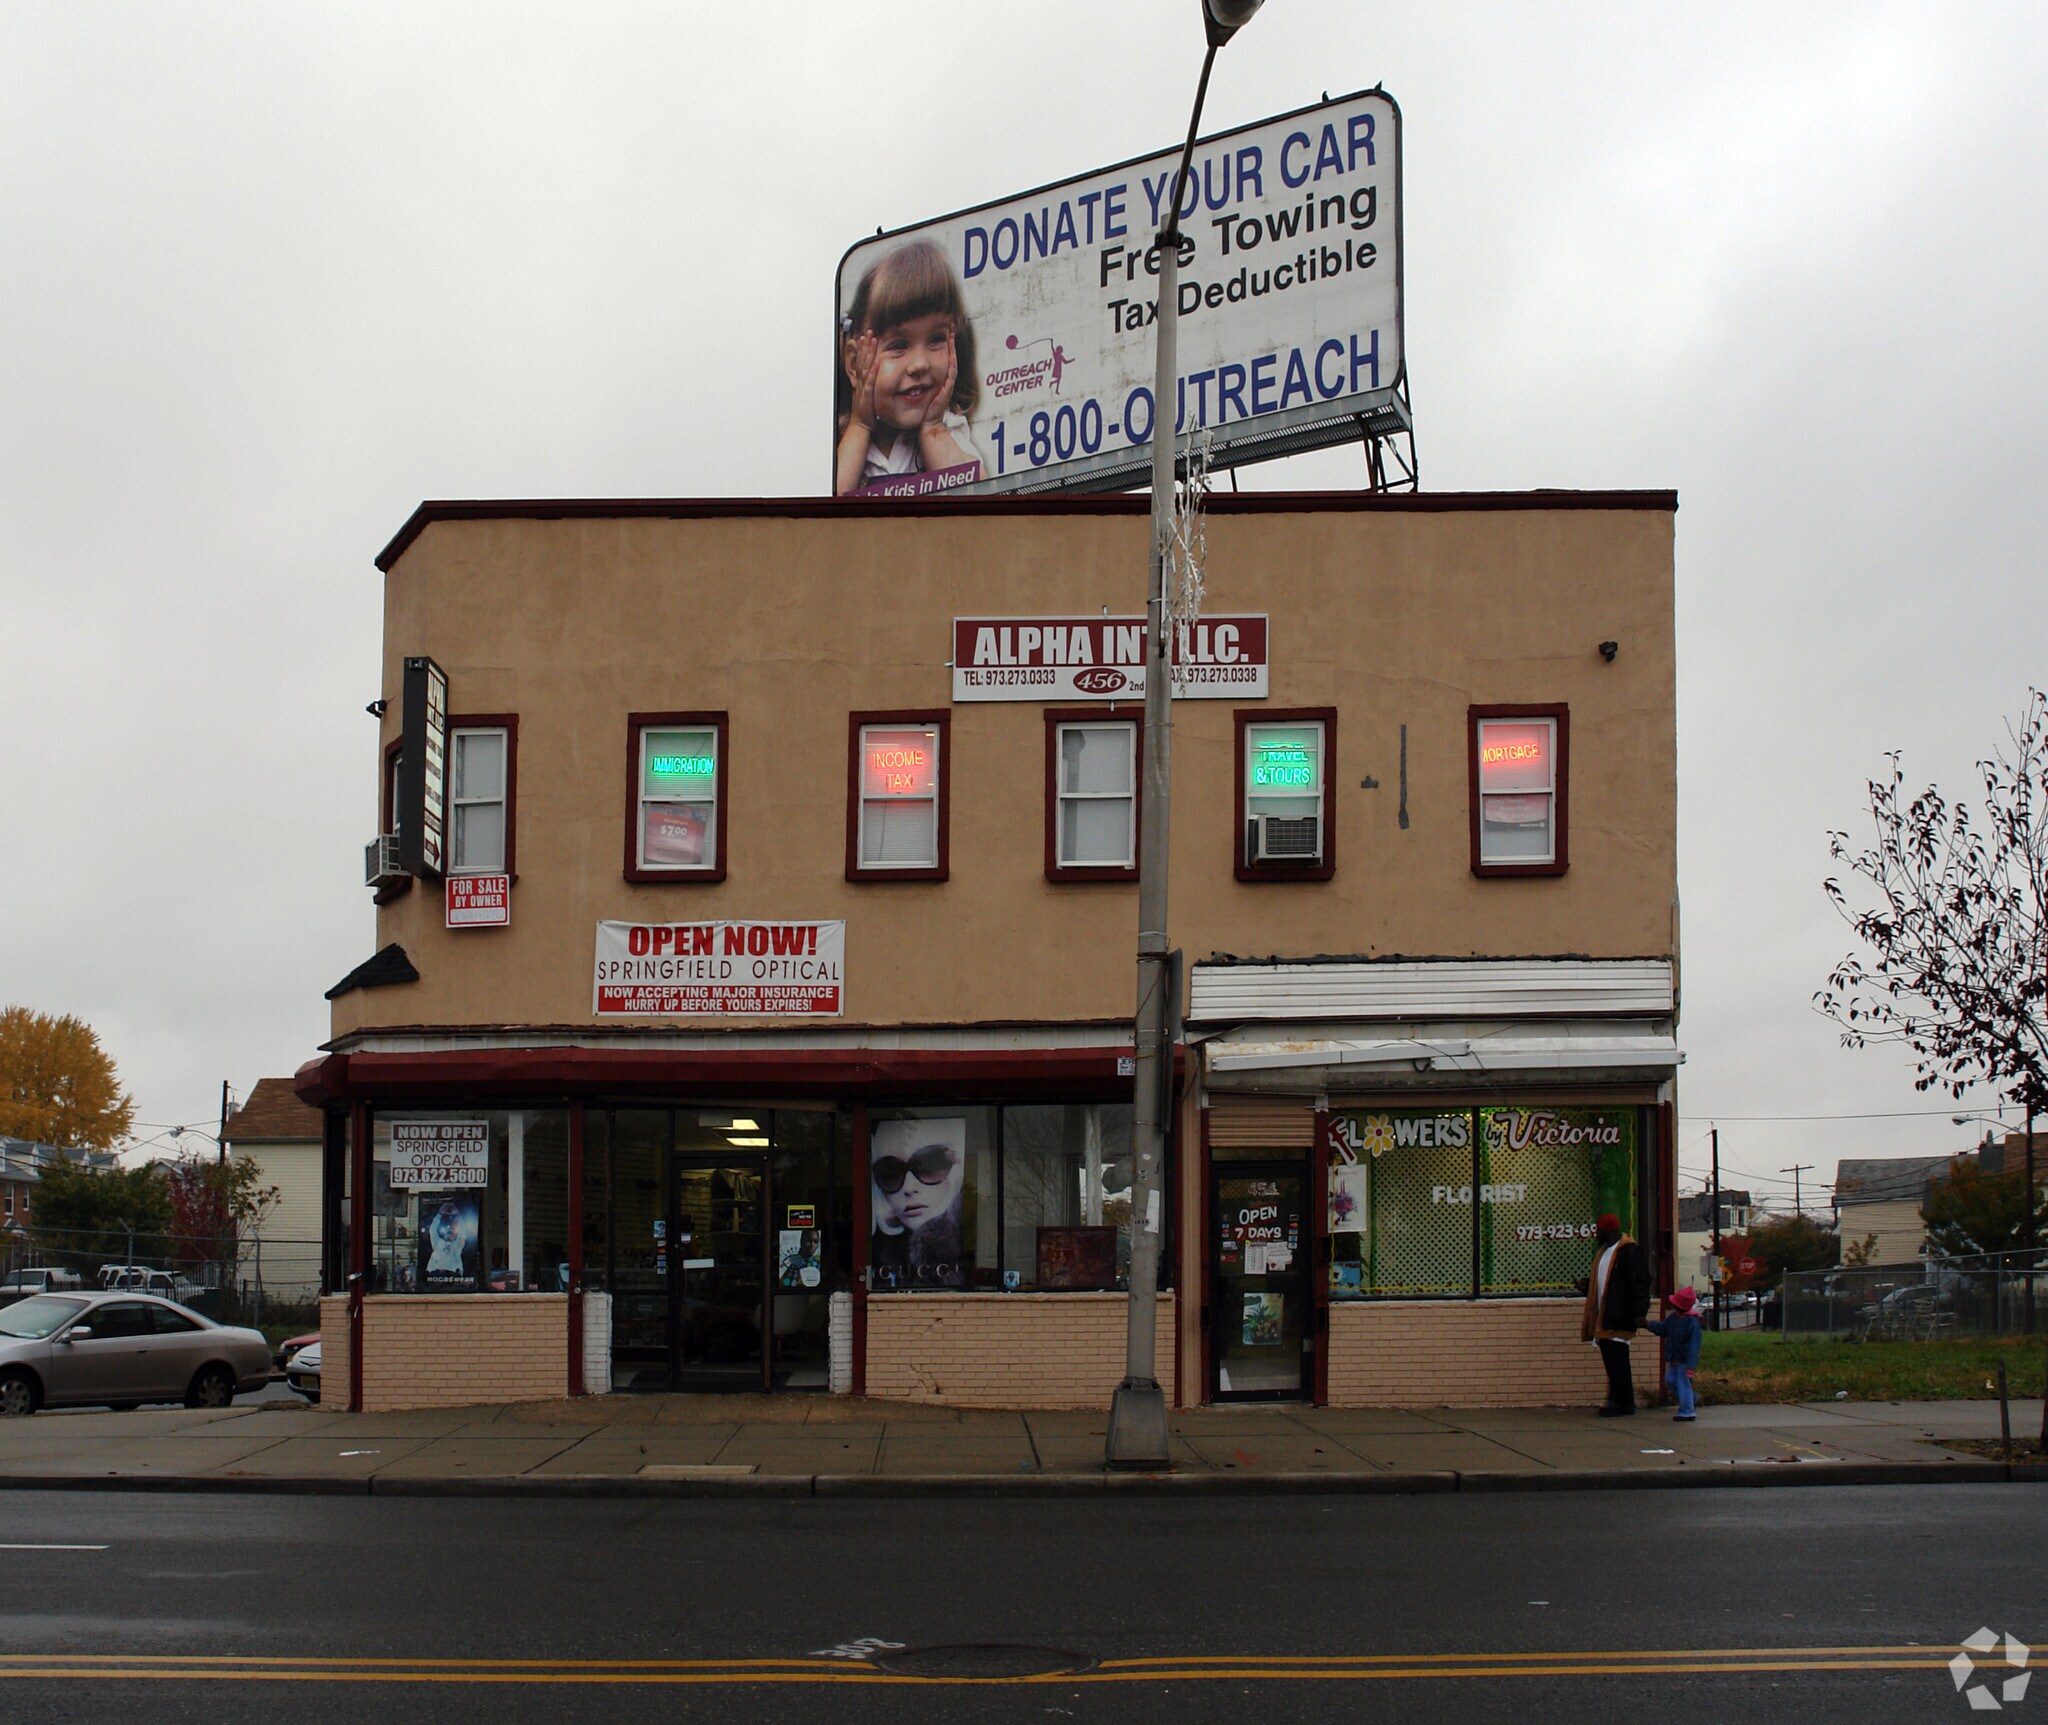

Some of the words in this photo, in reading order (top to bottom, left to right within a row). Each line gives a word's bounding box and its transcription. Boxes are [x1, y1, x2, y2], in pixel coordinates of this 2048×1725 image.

[963, 184, 1128, 280] DONATE
[1141, 146, 1264, 227] YOUR
[1280, 113, 1377, 188] CAR
[1100, 235, 1196, 288] Free
[1212, 186, 1378, 256] Towing
[1108, 298, 1159, 334] Tax
[1178, 242, 1378, 316] Deductible
[986, 358, 1053, 386] OUTREACH
[995, 375, 1044, 398] CENTER
[884, 483, 916, 497] Kids
[919, 478, 933, 494] in
[937, 466, 976, 491] Need
[973, 625, 1094, 666] ALPHA
[1178, 624, 1249, 664] LLC.
[964, 671, 983, 686] TEL:
[986, 669, 1056, 686] 973.273.0333
[1077, 671, 1122, 689] 456
[1188, 667, 1257, 683] 973.273.0338
[1129, 681, 1145, 691] 2nd
[873, 750, 924, 768] INCOME
[1261, 745, 1309, 761] TRAVEL
[653, 756, 714, 774] IMMIGRATION
[886, 773, 912, 789] TAX
[660, 824, 688, 837] $7.00
[452, 880, 473, 895] FOR
[478, 878, 505, 894] SALE
[455, 895, 467, 908] BY
[470, 894, 503, 907] OWNER
[628, 926, 714, 957] OPEN
[723, 926, 818, 956] NOW!
[597, 960, 732, 980] SPRINGFIELD
[752, 959, 839, 981] OPTICAL
[604, 987, 633, 998] NOW
[636, 987, 709, 999] ACCEPTING
[712, 987, 757, 999] MAJOR
[760, 987, 833, 999] INSURANCE
[624, 998, 661, 1011] HURRY
[664, 998, 680, 1011] UP
[682, 999, 723, 1011] BEFORE
[725, 999, 762, 1011] YOURS
[765, 999, 812, 1011] EXPIRES!
[398, 1126, 438, 1139] NOW
[441, 1126, 483, 1139] OPEN
[1493, 1111, 1620, 1151] Victoria
[397, 1141, 483, 1153] SPRINGFIELD
[411, 1154, 468, 1167] OPTICAL
[393, 1168, 485, 1183] 973.622.5600
[1432, 1184, 1528, 1204] FLORIST
[1238, 1205, 1278, 1225] OPEN
[1234, 1227, 1244, 1239] 7
[1248, 1226, 1282, 1239] DAYS
